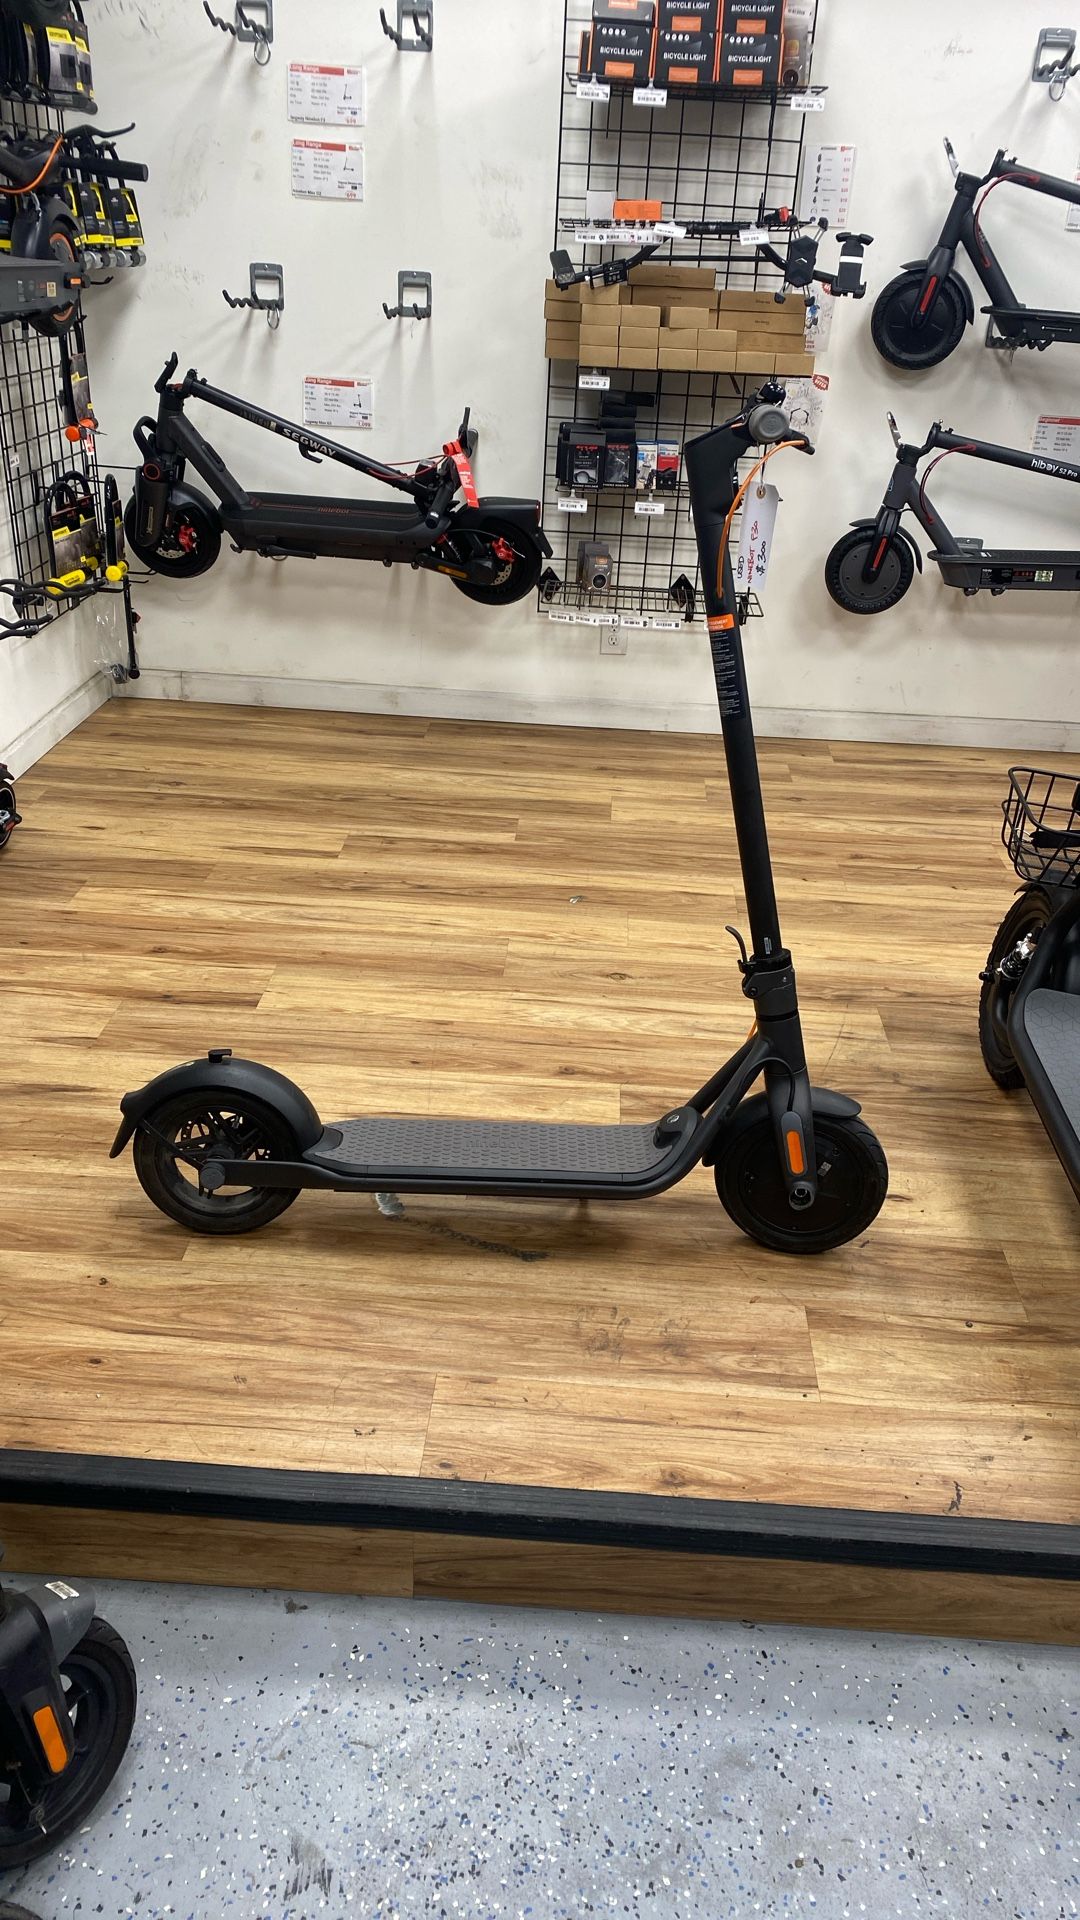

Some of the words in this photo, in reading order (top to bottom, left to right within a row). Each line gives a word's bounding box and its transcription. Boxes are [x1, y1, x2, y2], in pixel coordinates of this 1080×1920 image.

[666, 1, 692, 9] BICYCLE
[731, 4, 756, 12] BICYCLE
[600, 46, 625, 55] BICYCLE
[626, 48, 643, 56] LIGHT
[663, 52, 688, 60] BICYCLE
[282, 427, 336, 456] SEGWAY
[1059, 467, 1067, 475] S2
[1067, 469, 1078, 478] Pro
[737, 555, 745, 579] USED
[747, 546, 756, 584] NINEBOT
